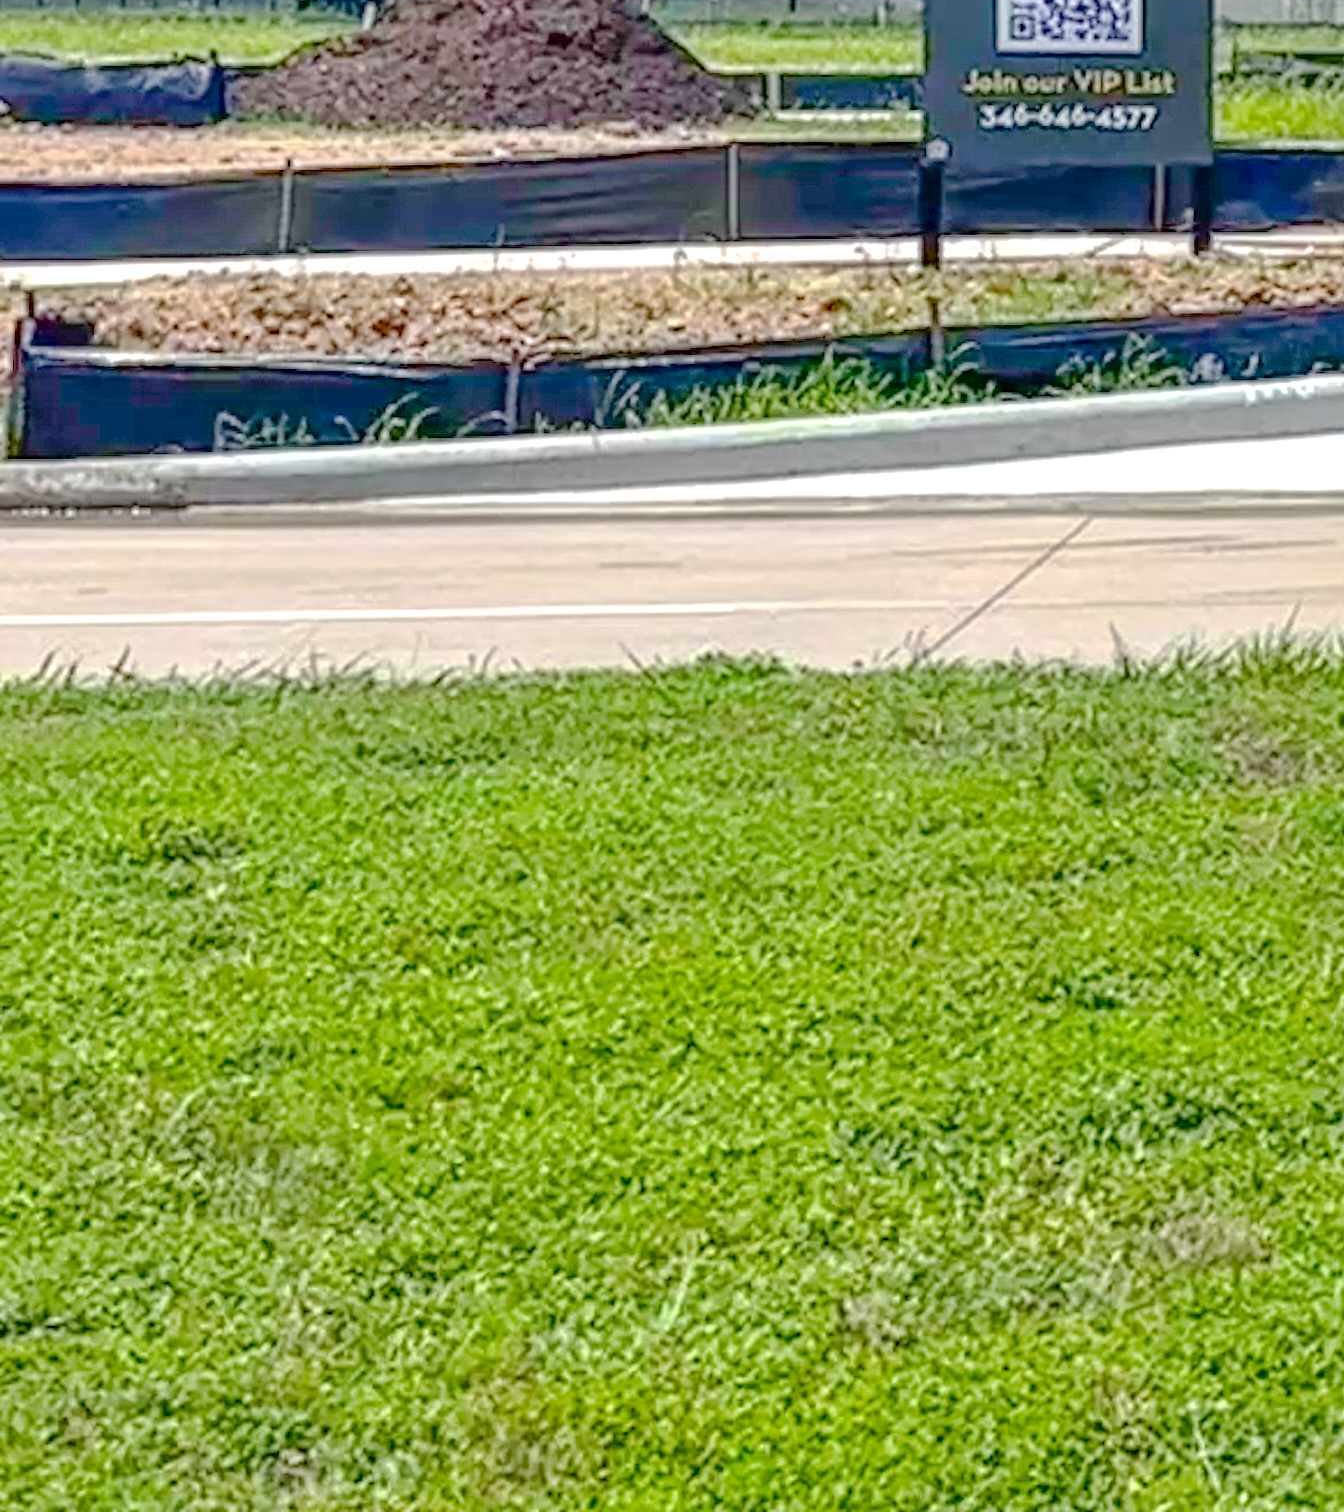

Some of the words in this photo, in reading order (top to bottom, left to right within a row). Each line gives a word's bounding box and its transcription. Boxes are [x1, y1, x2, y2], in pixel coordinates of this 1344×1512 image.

[963, 68, 1018, 93] Join
[1024, 75, 1065, 93] our
[1073, 70, 1122, 93] VIP
[1126, 70, 1176, 94] List
[979, 104, 1158, 129] 346-646-4577
